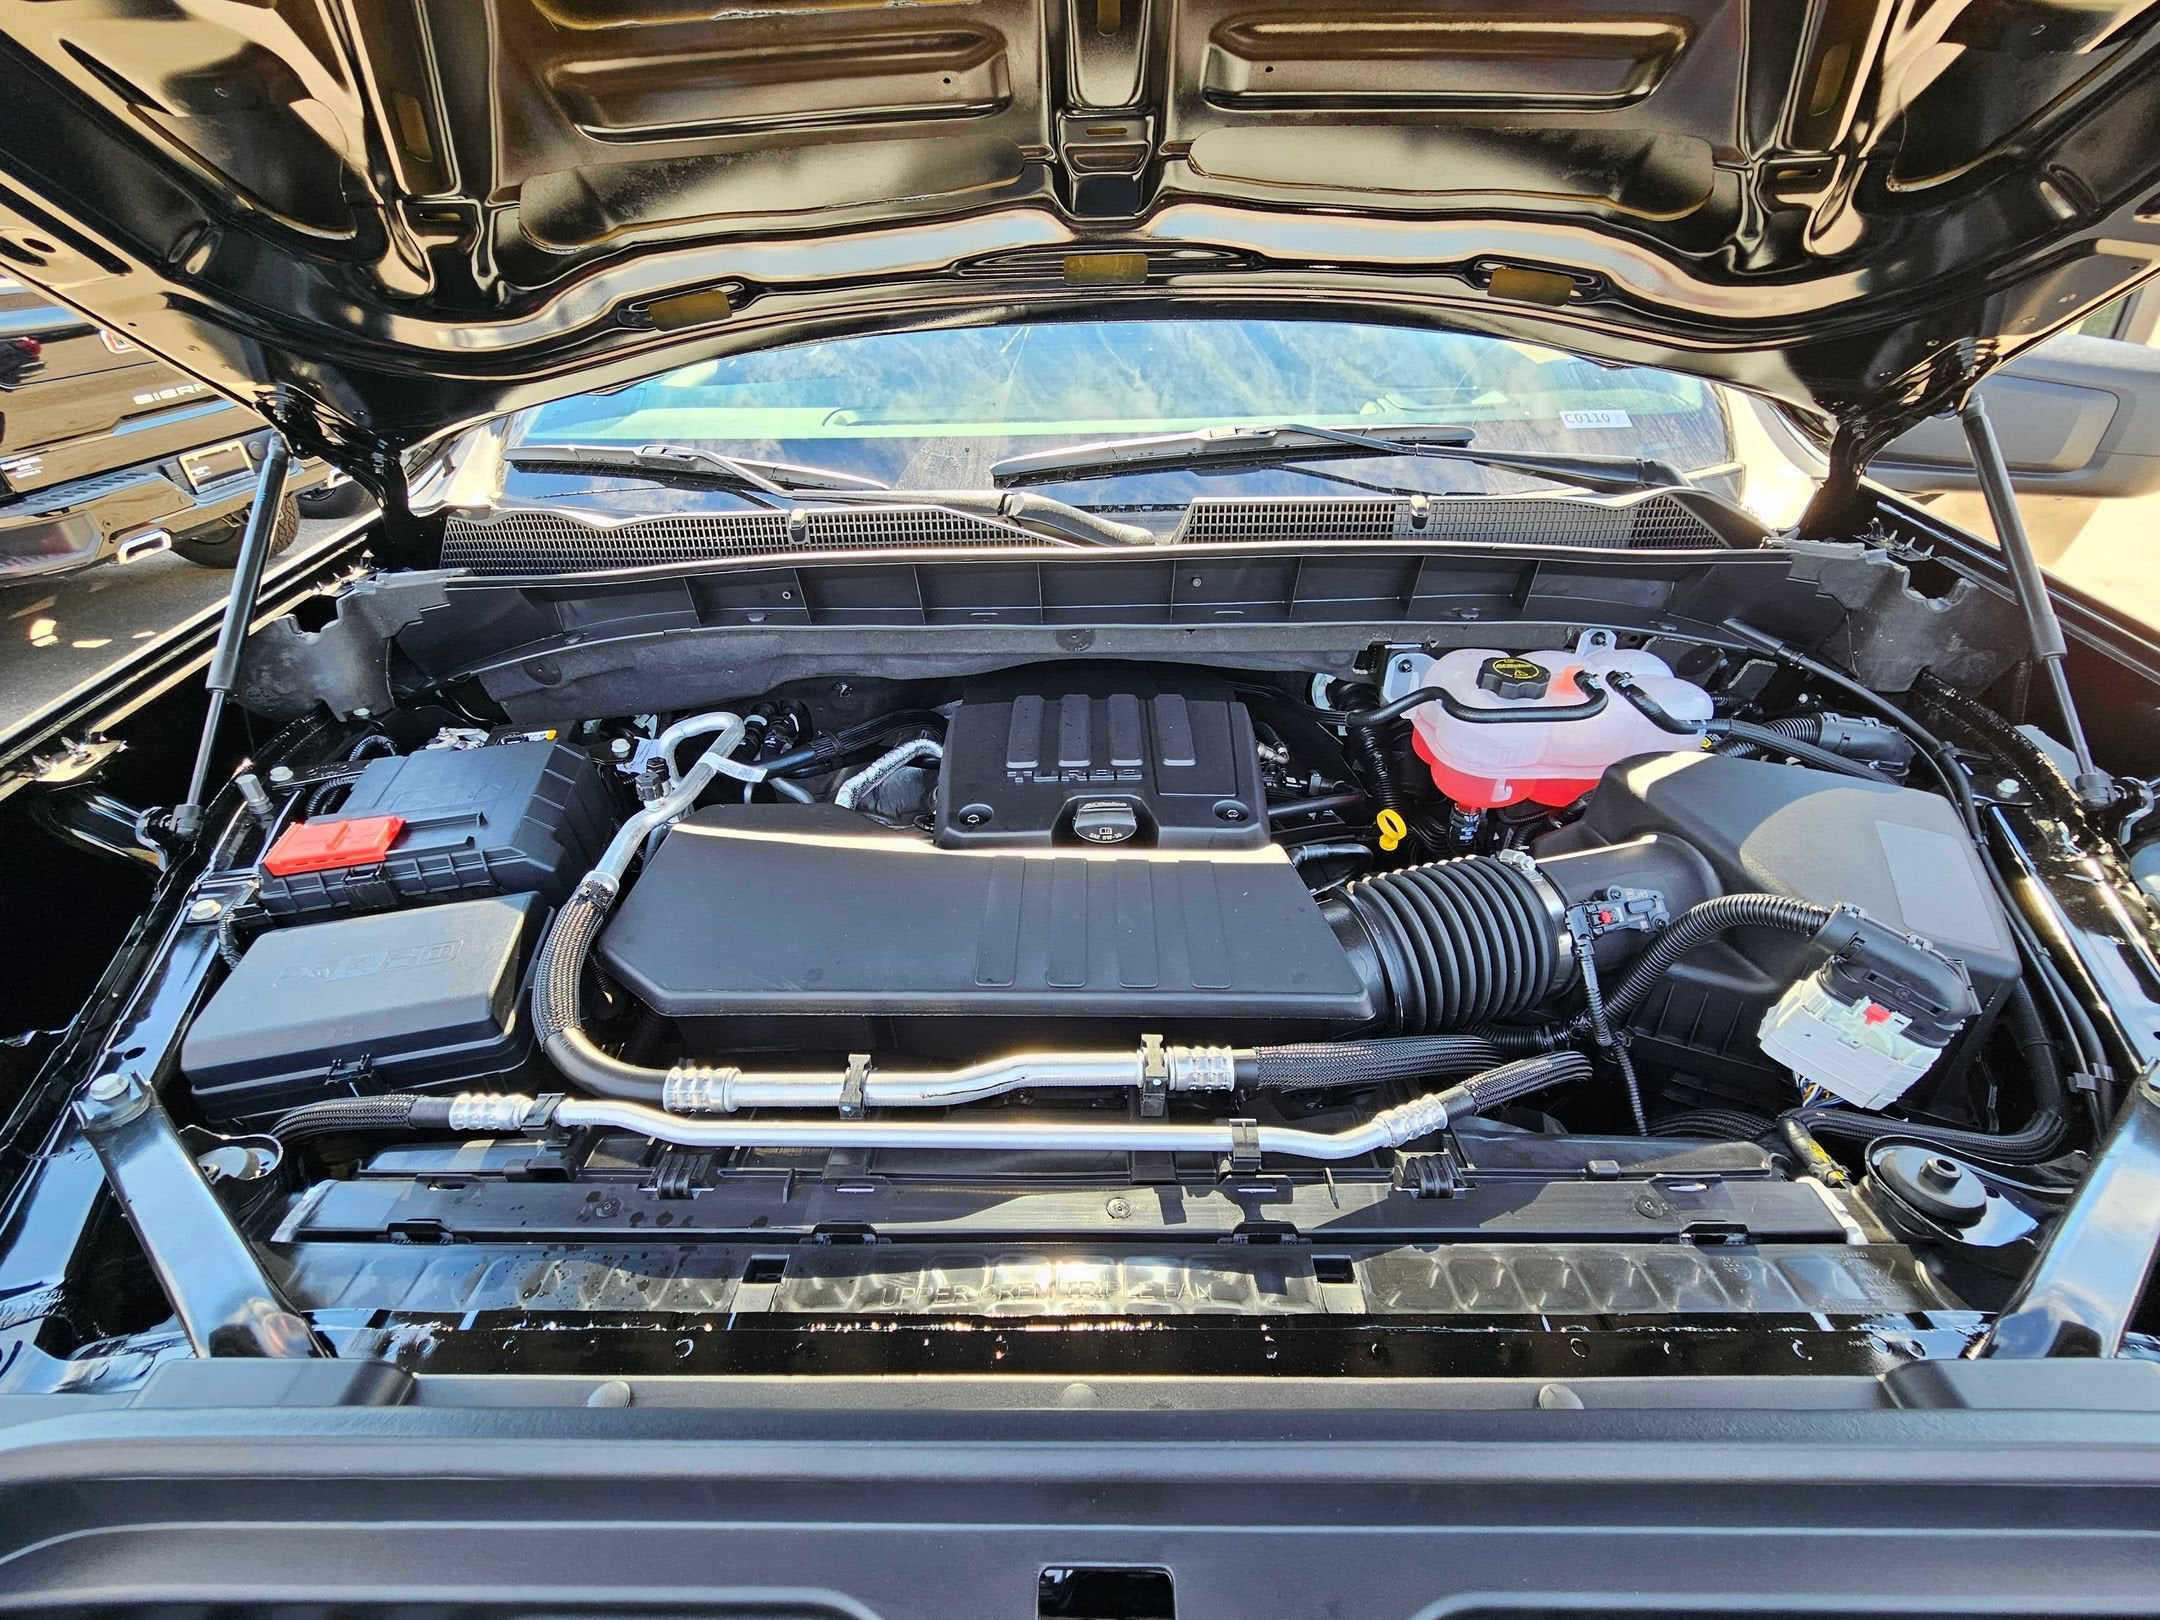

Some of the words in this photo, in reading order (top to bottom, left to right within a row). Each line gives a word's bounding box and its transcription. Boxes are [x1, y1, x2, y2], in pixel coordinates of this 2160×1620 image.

[1564, 413, 1611, 424] C0110
[880, 1286, 969, 1306] UPPER
[1063, 1280, 1154, 1301] TRIPLE
[1164, 1282, 1212, 1301] FAN
